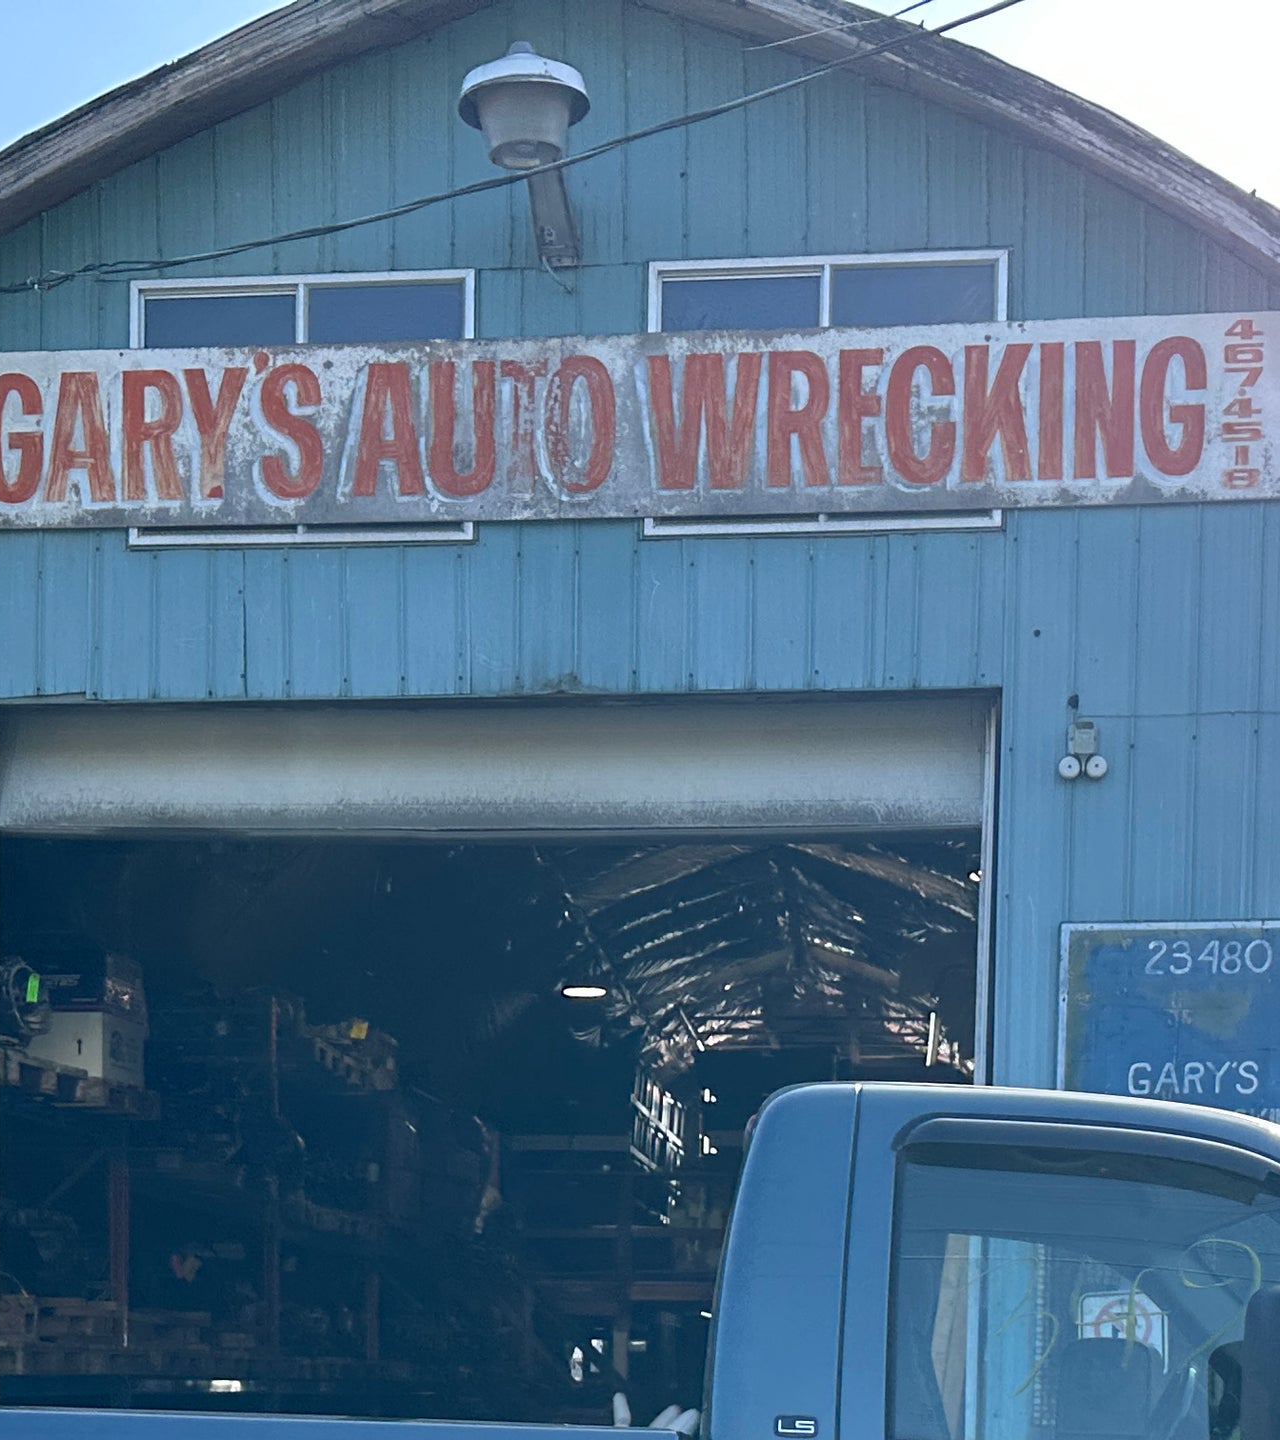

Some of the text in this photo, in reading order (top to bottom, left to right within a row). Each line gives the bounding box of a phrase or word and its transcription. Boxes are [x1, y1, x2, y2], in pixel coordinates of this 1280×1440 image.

[350, 354, 617, 498] AUTO
[646, 335, 1209, 491] WRECKING
[1144, 938, 1273, 975] 23480
[1127, 1060, 1260, 1096] GARY'S
[776, 1418, 816, 1434] LS
